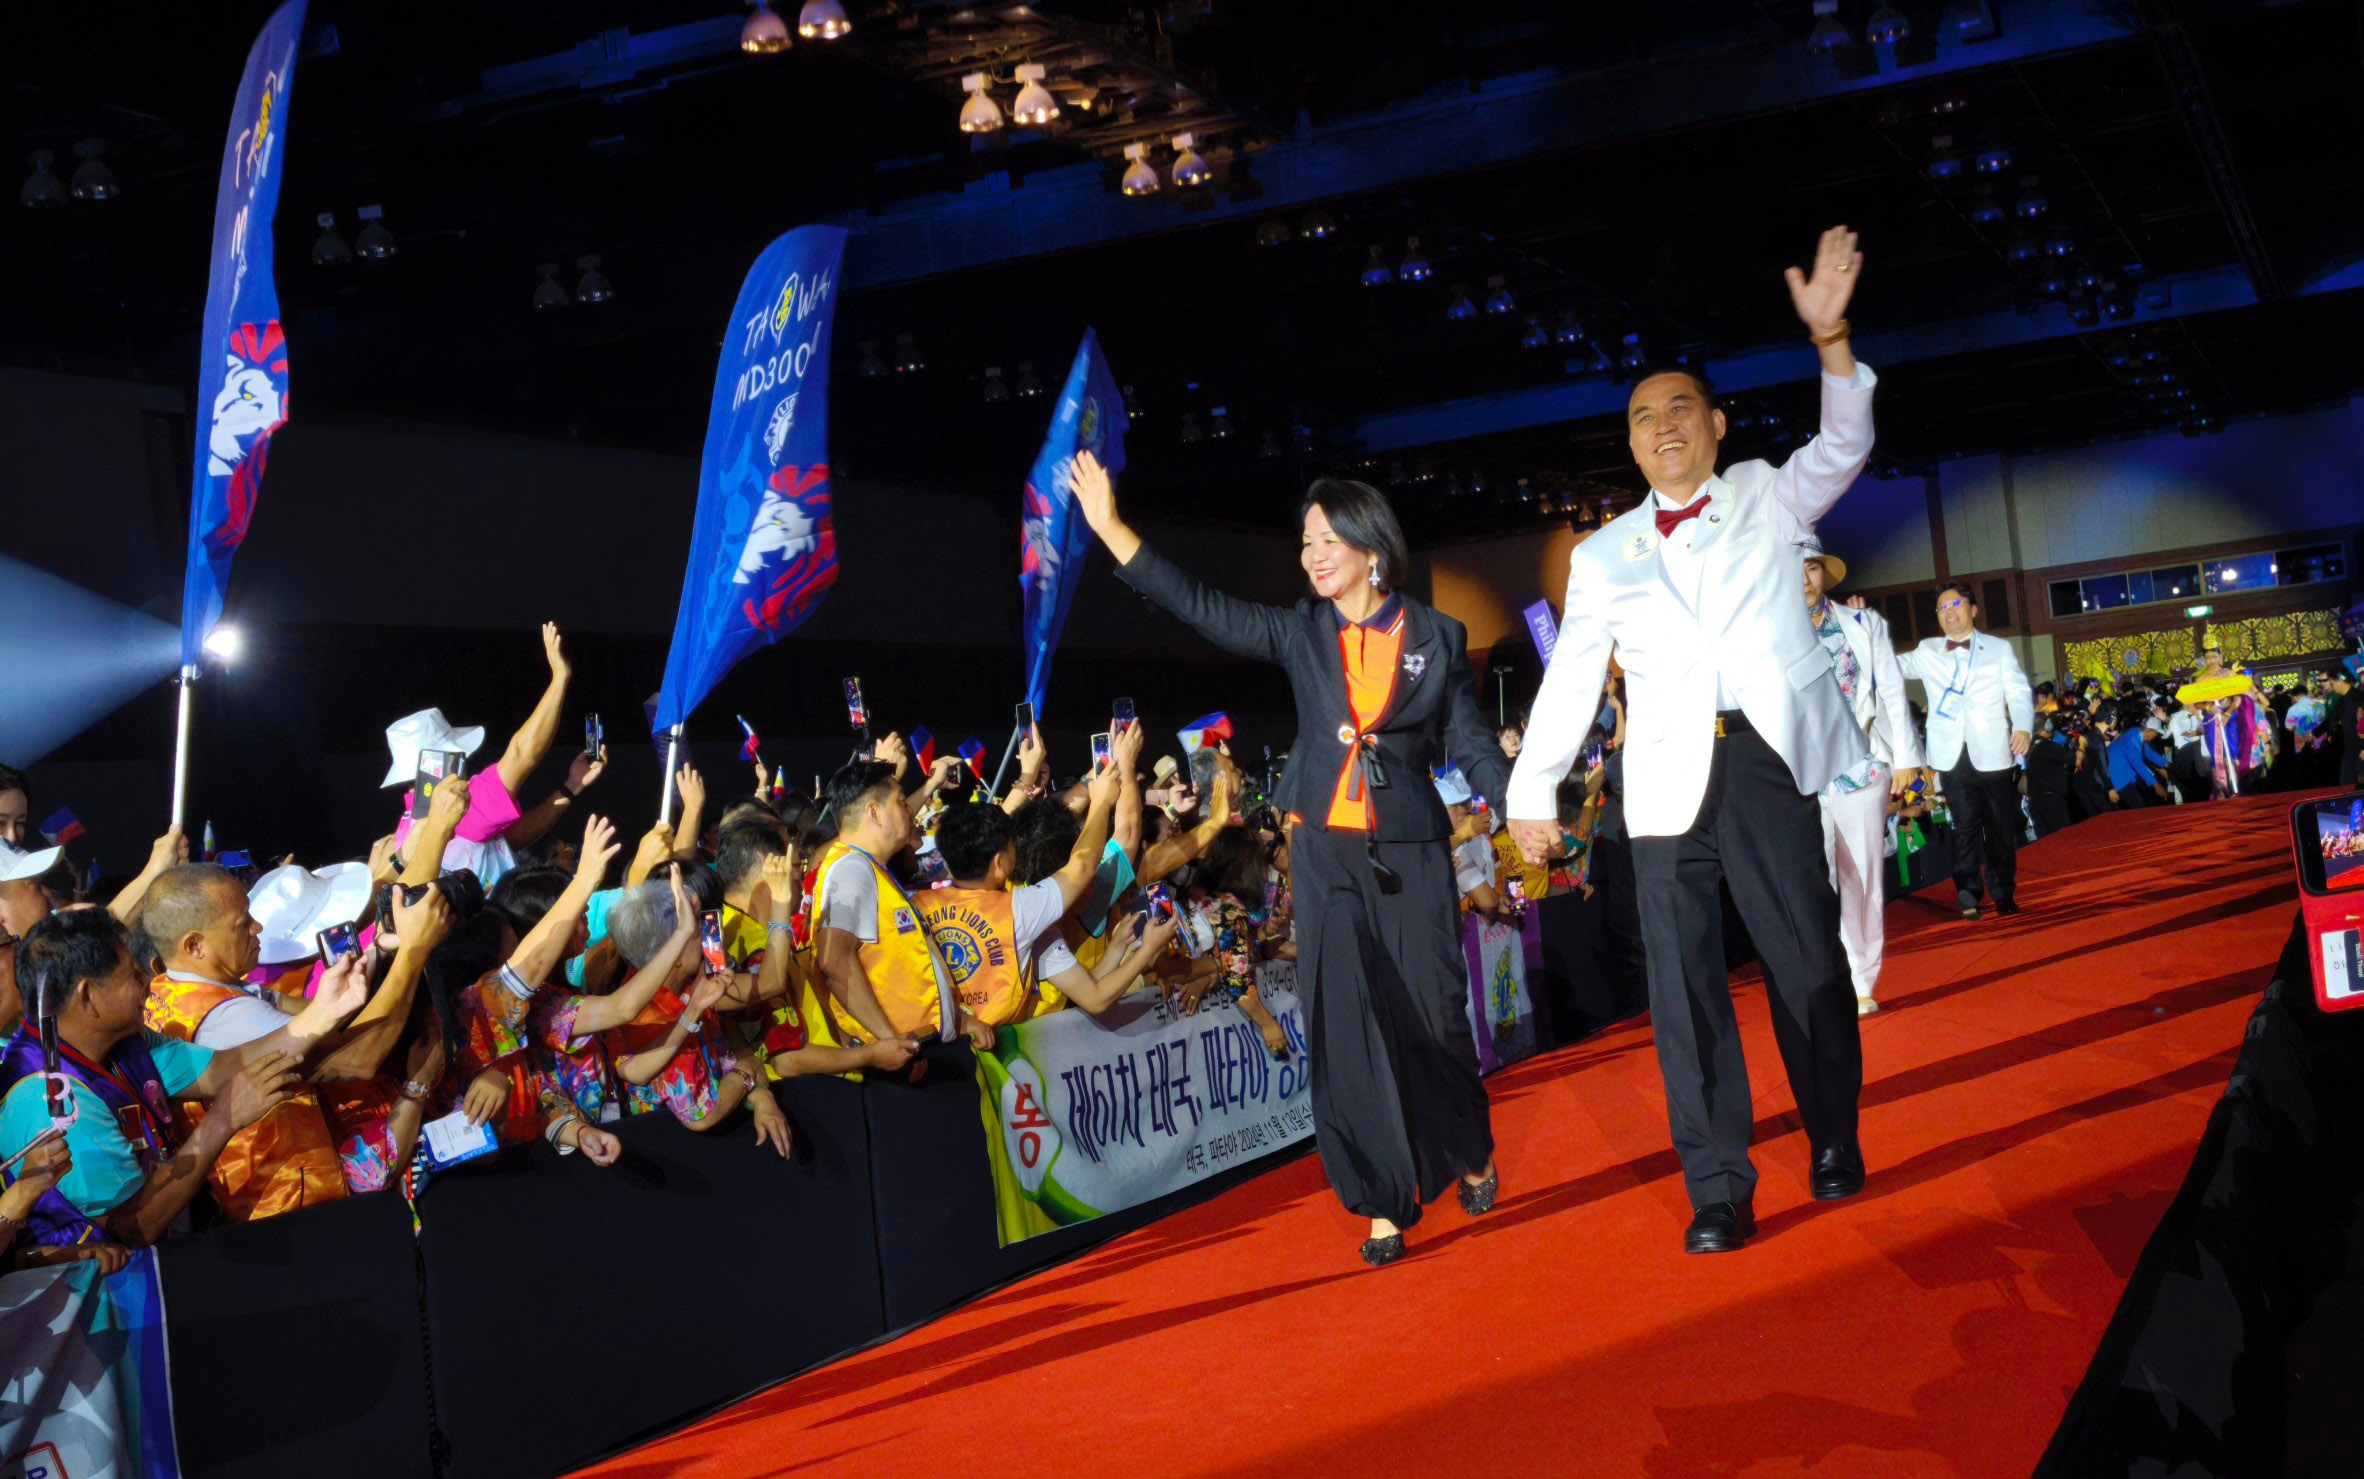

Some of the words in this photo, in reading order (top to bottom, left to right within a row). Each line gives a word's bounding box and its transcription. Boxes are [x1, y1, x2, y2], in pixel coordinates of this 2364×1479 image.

[926, 905, 957, 927] EONG
[960, 908, 993, 939] LIONS
[985, 937, 1005, 967] CLUB
[946, 945, 959, 965] L
[960, 991, 989, 1006] KOREA
[1061, 1053, 1145, 1163] 제61차
[1146, 1038, 1203, 1137] 태국,
[1201, 1021, 1269, 1114] 파타야
[1186, 1145, 1208, 1173] 태국,
[1209, 1133, 1239, 1163] 파타야
[1241, 1123, 1268, 1151] 2024년
